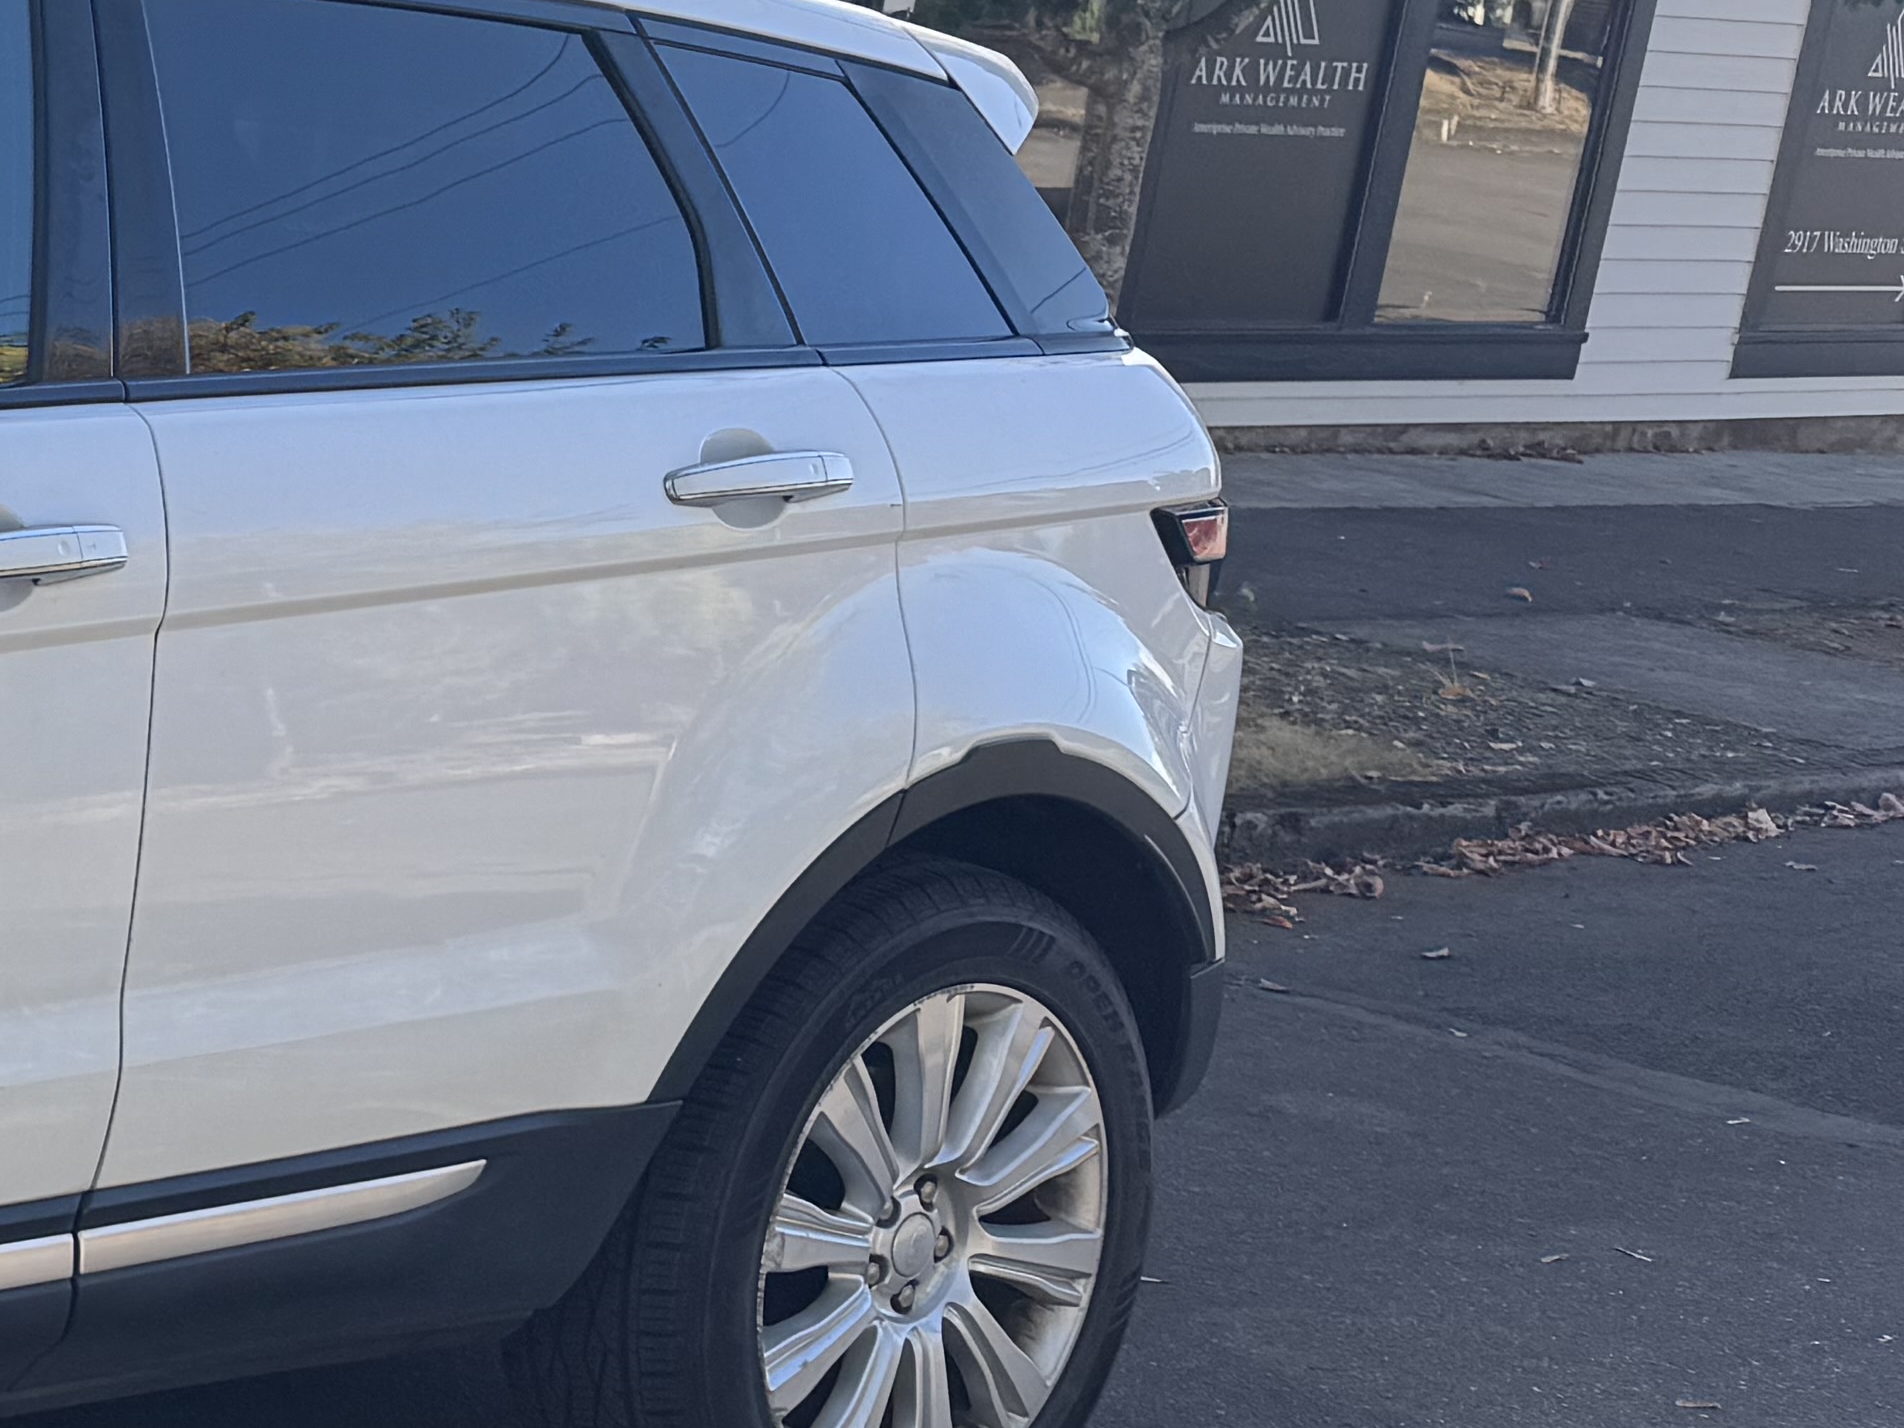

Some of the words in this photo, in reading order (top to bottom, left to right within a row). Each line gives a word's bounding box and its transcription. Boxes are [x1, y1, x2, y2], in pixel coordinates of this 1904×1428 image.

[1190, 56, 1250, 86] ARK
[1259, 58, 1368, 91] WEALTH
[1219, 92, 1332, 108] MANAGEMENT
[1816, 89, 1862, 115] ARK
[1784, 230, 1822, 253] 2917
[1824, 230, 1898, 260] Washington
